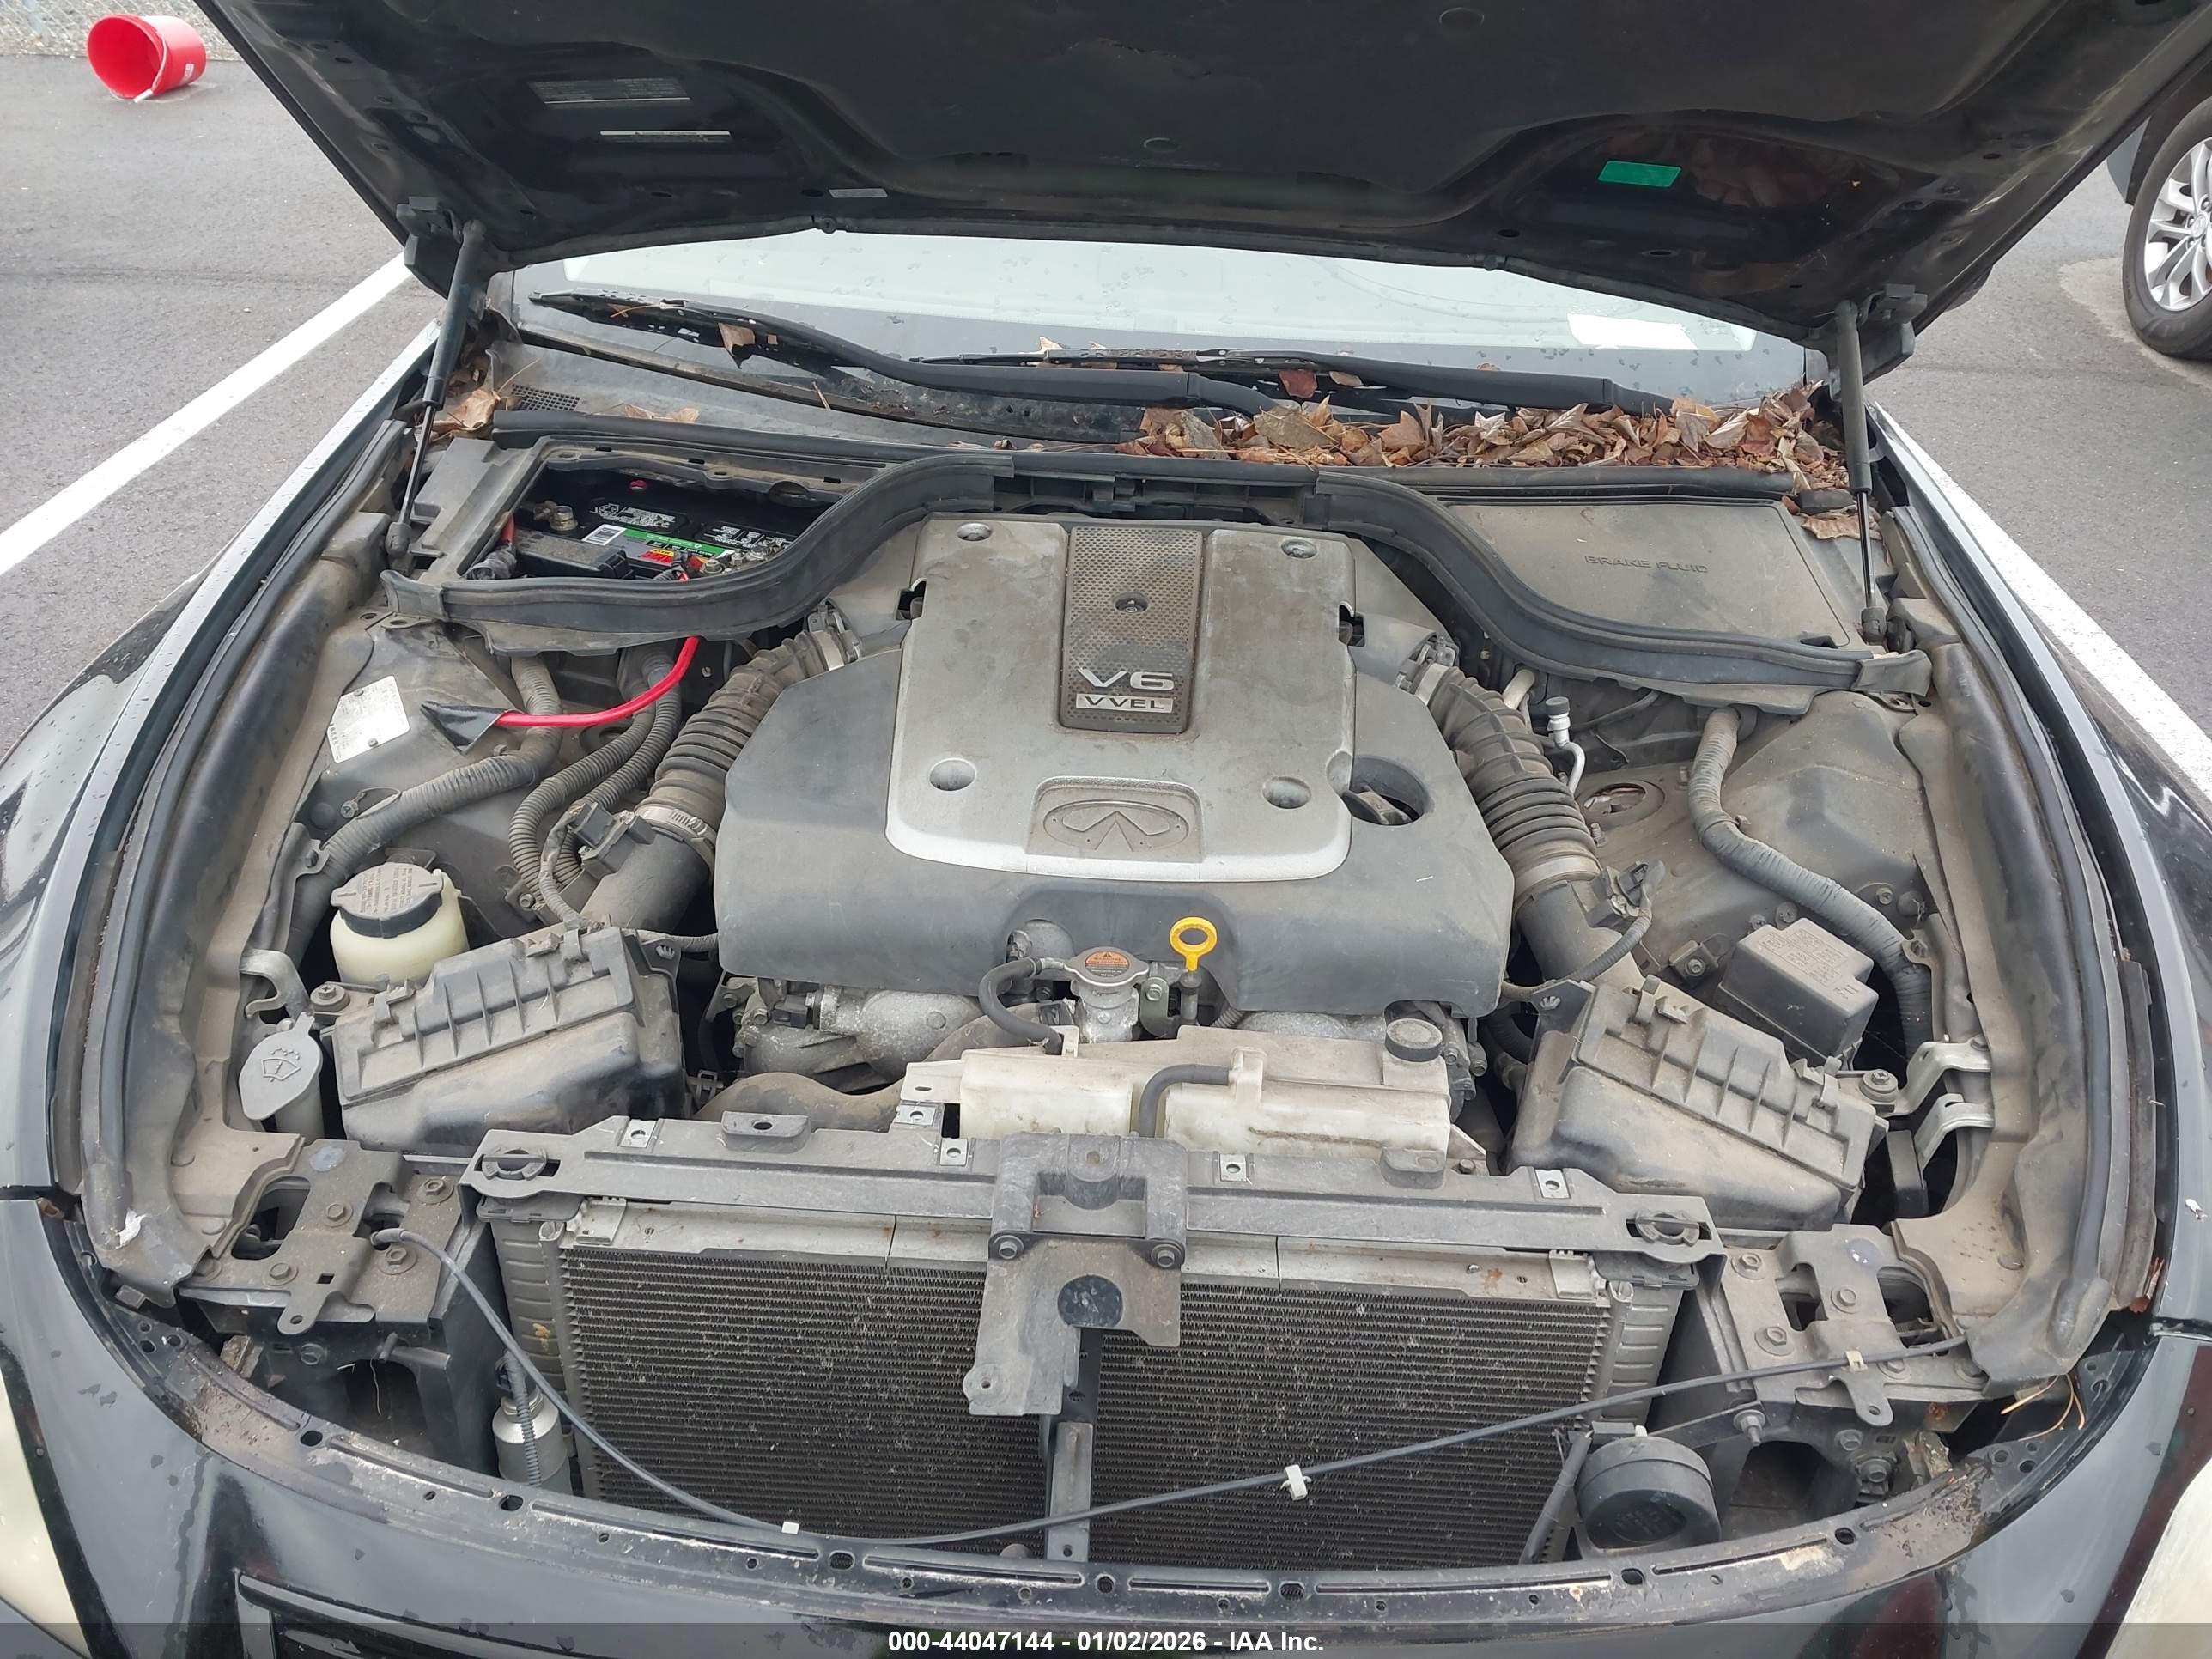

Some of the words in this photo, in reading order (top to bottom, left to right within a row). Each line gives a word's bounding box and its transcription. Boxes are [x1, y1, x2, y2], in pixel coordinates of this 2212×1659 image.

[1584, 556, 1651, 568] BRAKE
[1655, 561, 1709, 574] FLUID
[1077, 667, 1175, 690] V6
[1085, 696, 1165, 710] VVEL
